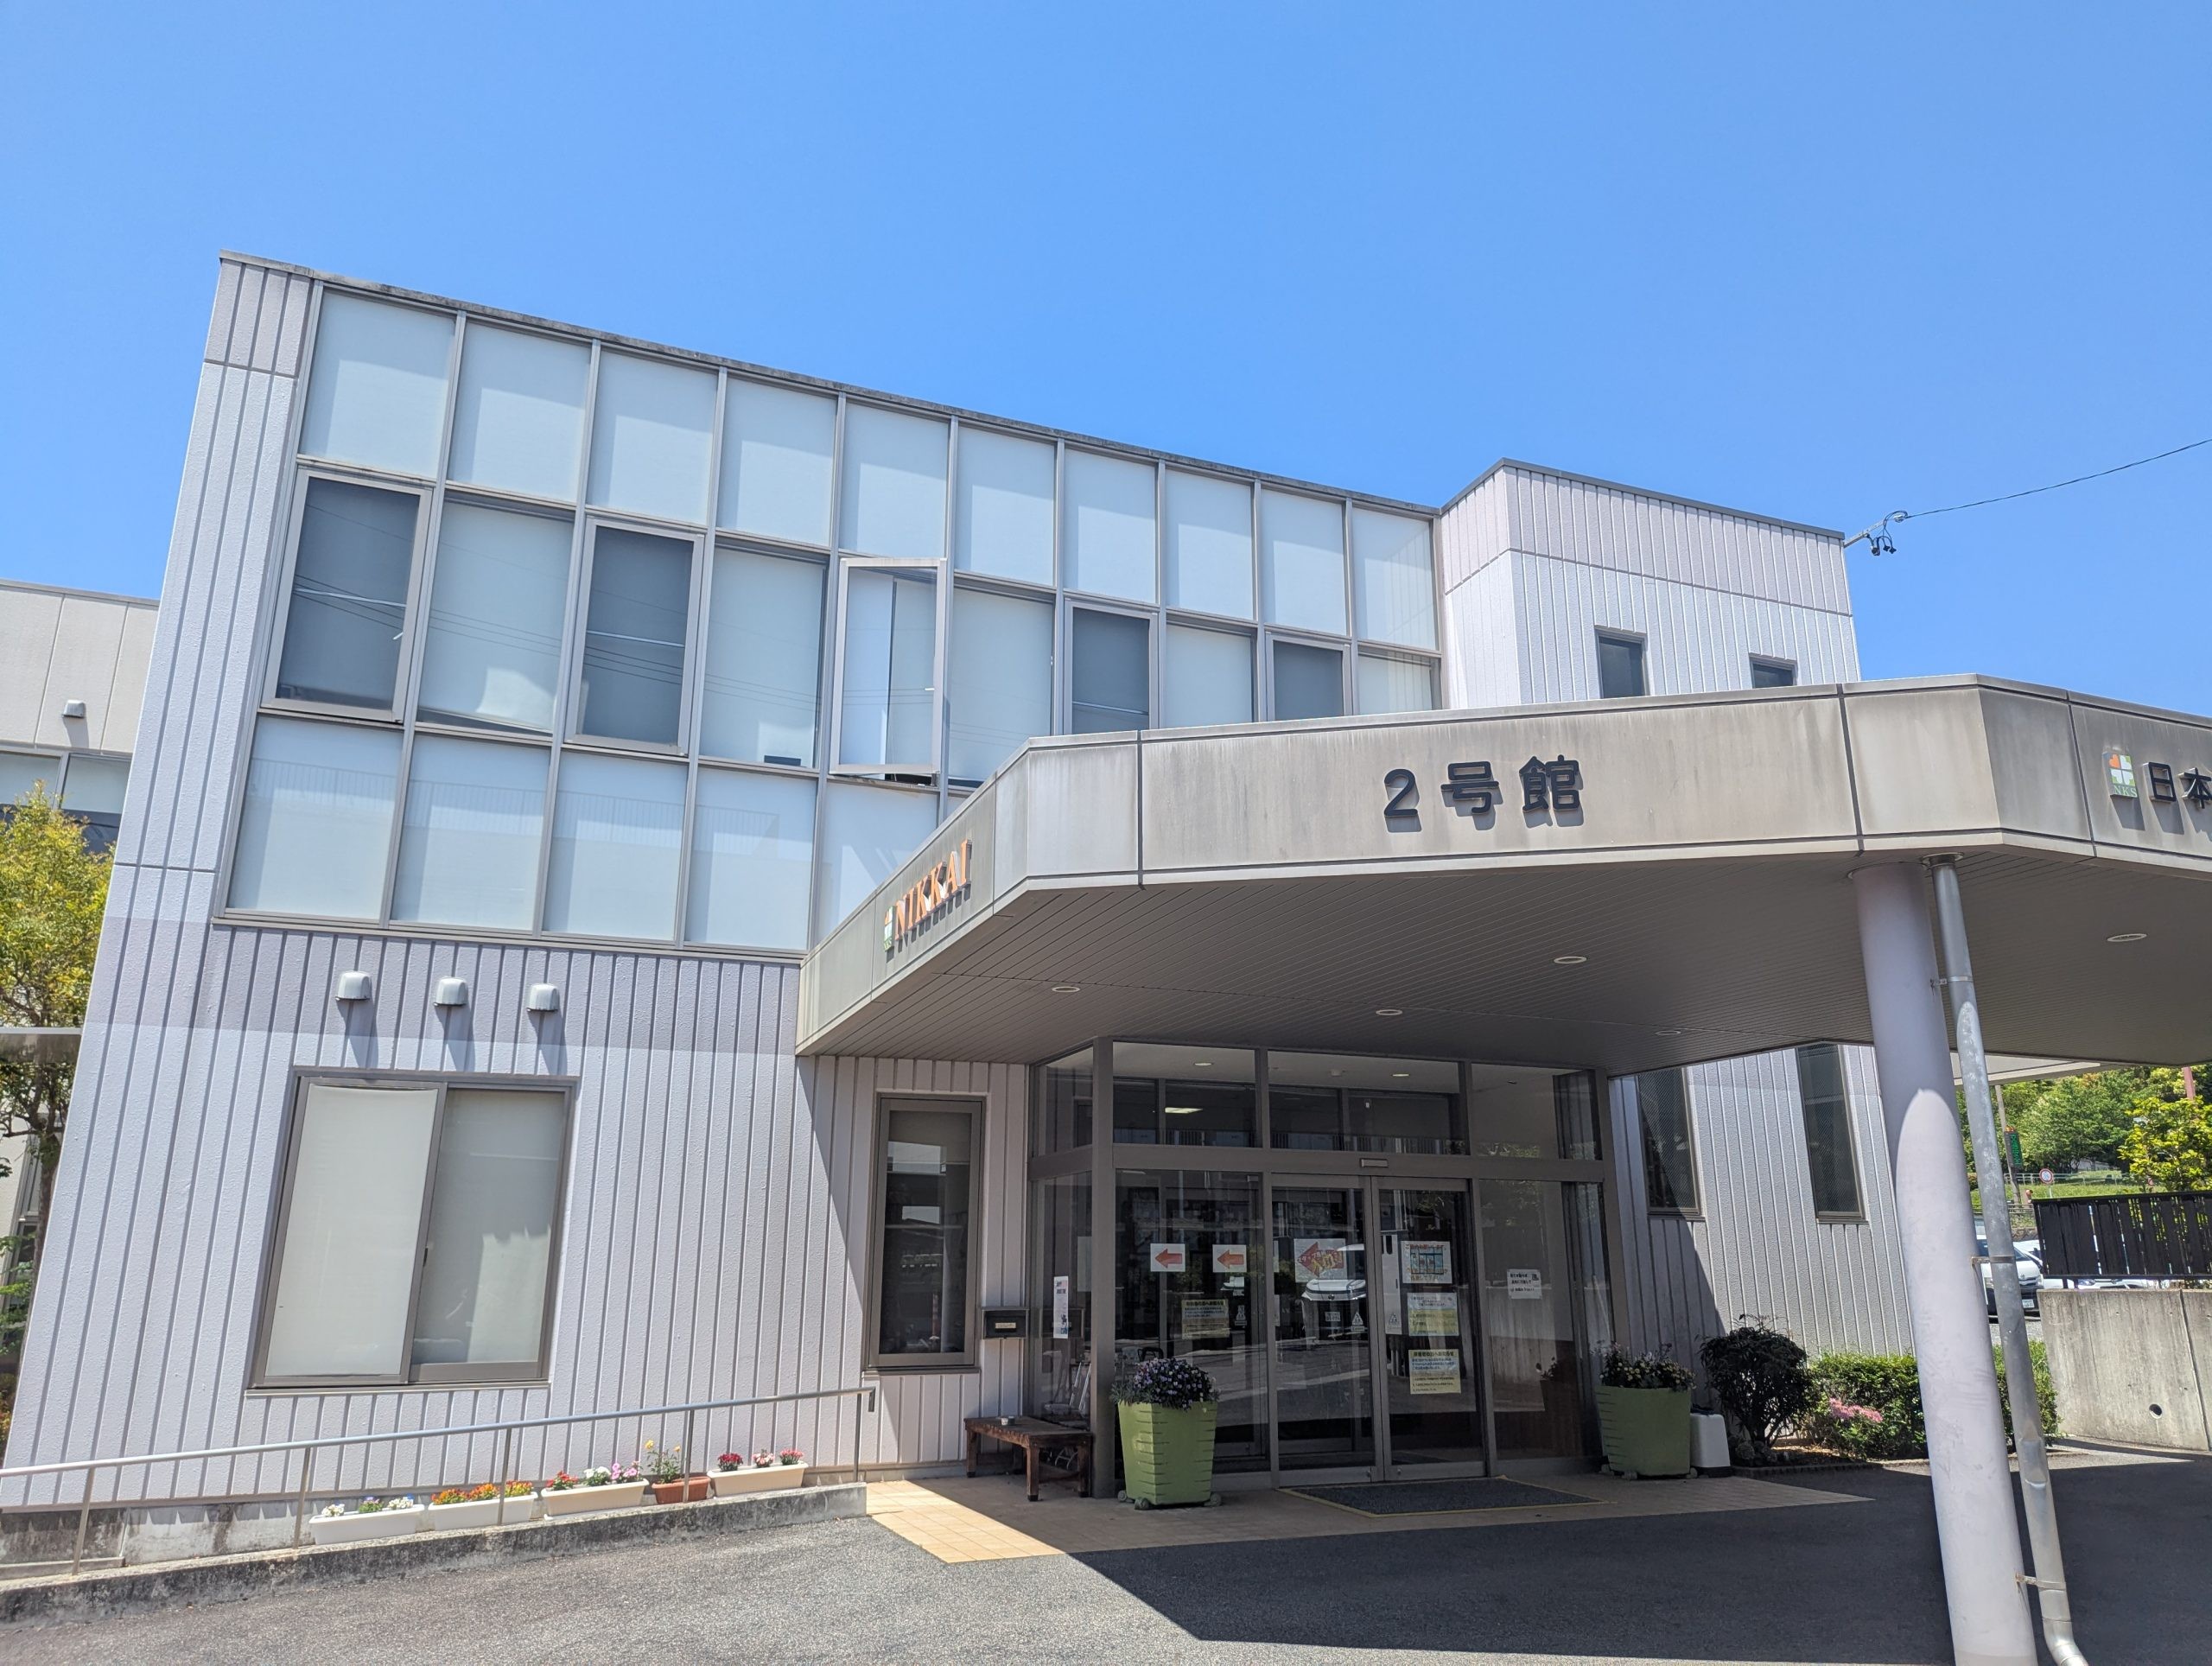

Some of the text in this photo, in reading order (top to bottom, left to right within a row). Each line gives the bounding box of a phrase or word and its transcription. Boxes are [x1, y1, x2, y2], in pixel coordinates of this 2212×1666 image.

[1383, 754, 1580, 816] 2号館
[2113, 785, 2138, 798] NKS
[2147, 761, 2212, 809] 日本
[894, 839, 972, 941] NIKKAI
